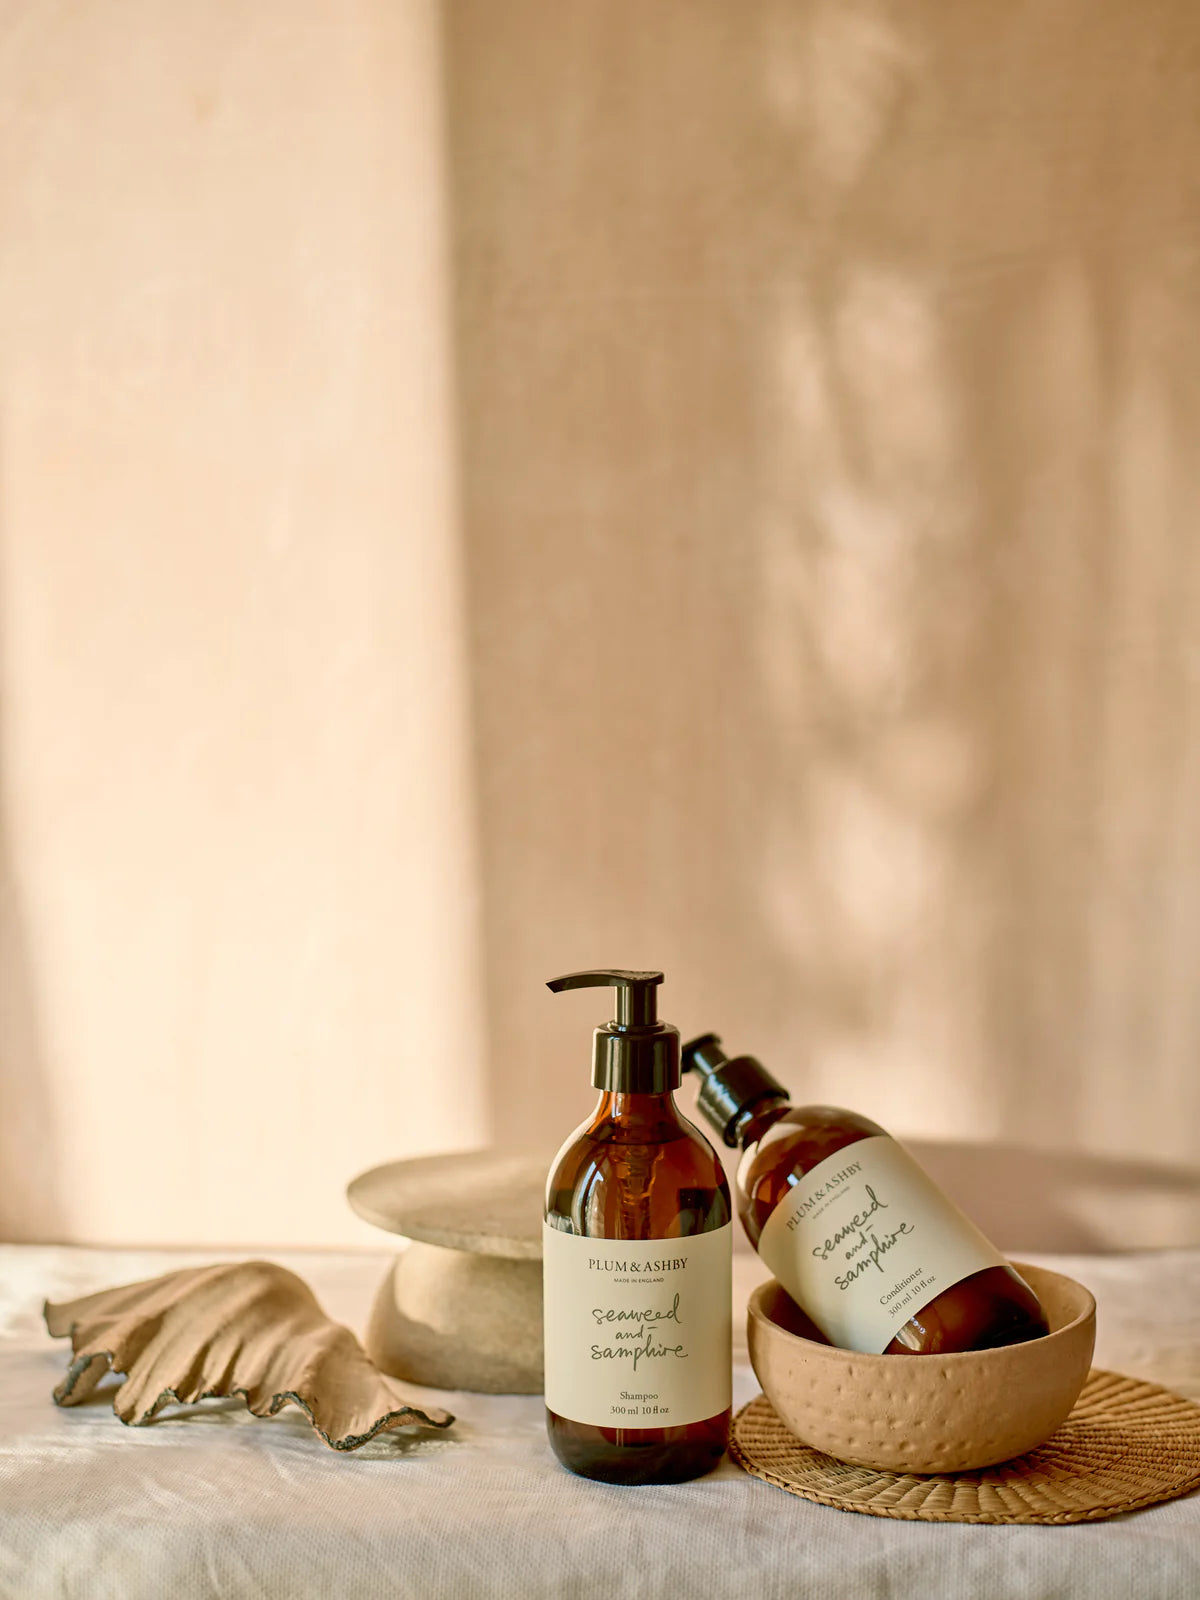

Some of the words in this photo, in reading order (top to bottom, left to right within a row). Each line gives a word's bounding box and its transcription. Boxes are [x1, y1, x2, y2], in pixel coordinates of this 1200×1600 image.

[786, 1197, 816, 1231] PLUM
[814, 1188, 826, 1201] &
[825, 1161, 862, 1193] ASHBY
[812, 1184, 889, 1261] seaweed
[834, 1222, 915, 1291] samphire
[845, 1231, 868, 1261] and
[589, 1258, 627, 1272] PLUM
[630, 1261, 641, 1273] &
[643, 1257, 688, 1272] ASHBY
[879, 1267, 923, 1305] Conditioner
[888, 1302, 902, 1319] 300
[902, 1292, 912, 1305] ml
[911, 1285, 921, 1296] 10
[927, 1275, 937, 1285] oz
[592, 1292, 682, 1325] seaweed
[615, 1324, 644, 1340] and
[591, 1334, 688, 1372] samphire
[610, 1405, 626, 1415] 300
[627, 1406, 639, 1415] ml
[642, 1406, 652, 1415] 10
[652, 1405, 659, 1414] fl
[620, 1391, 659, 1403] Shampoo
